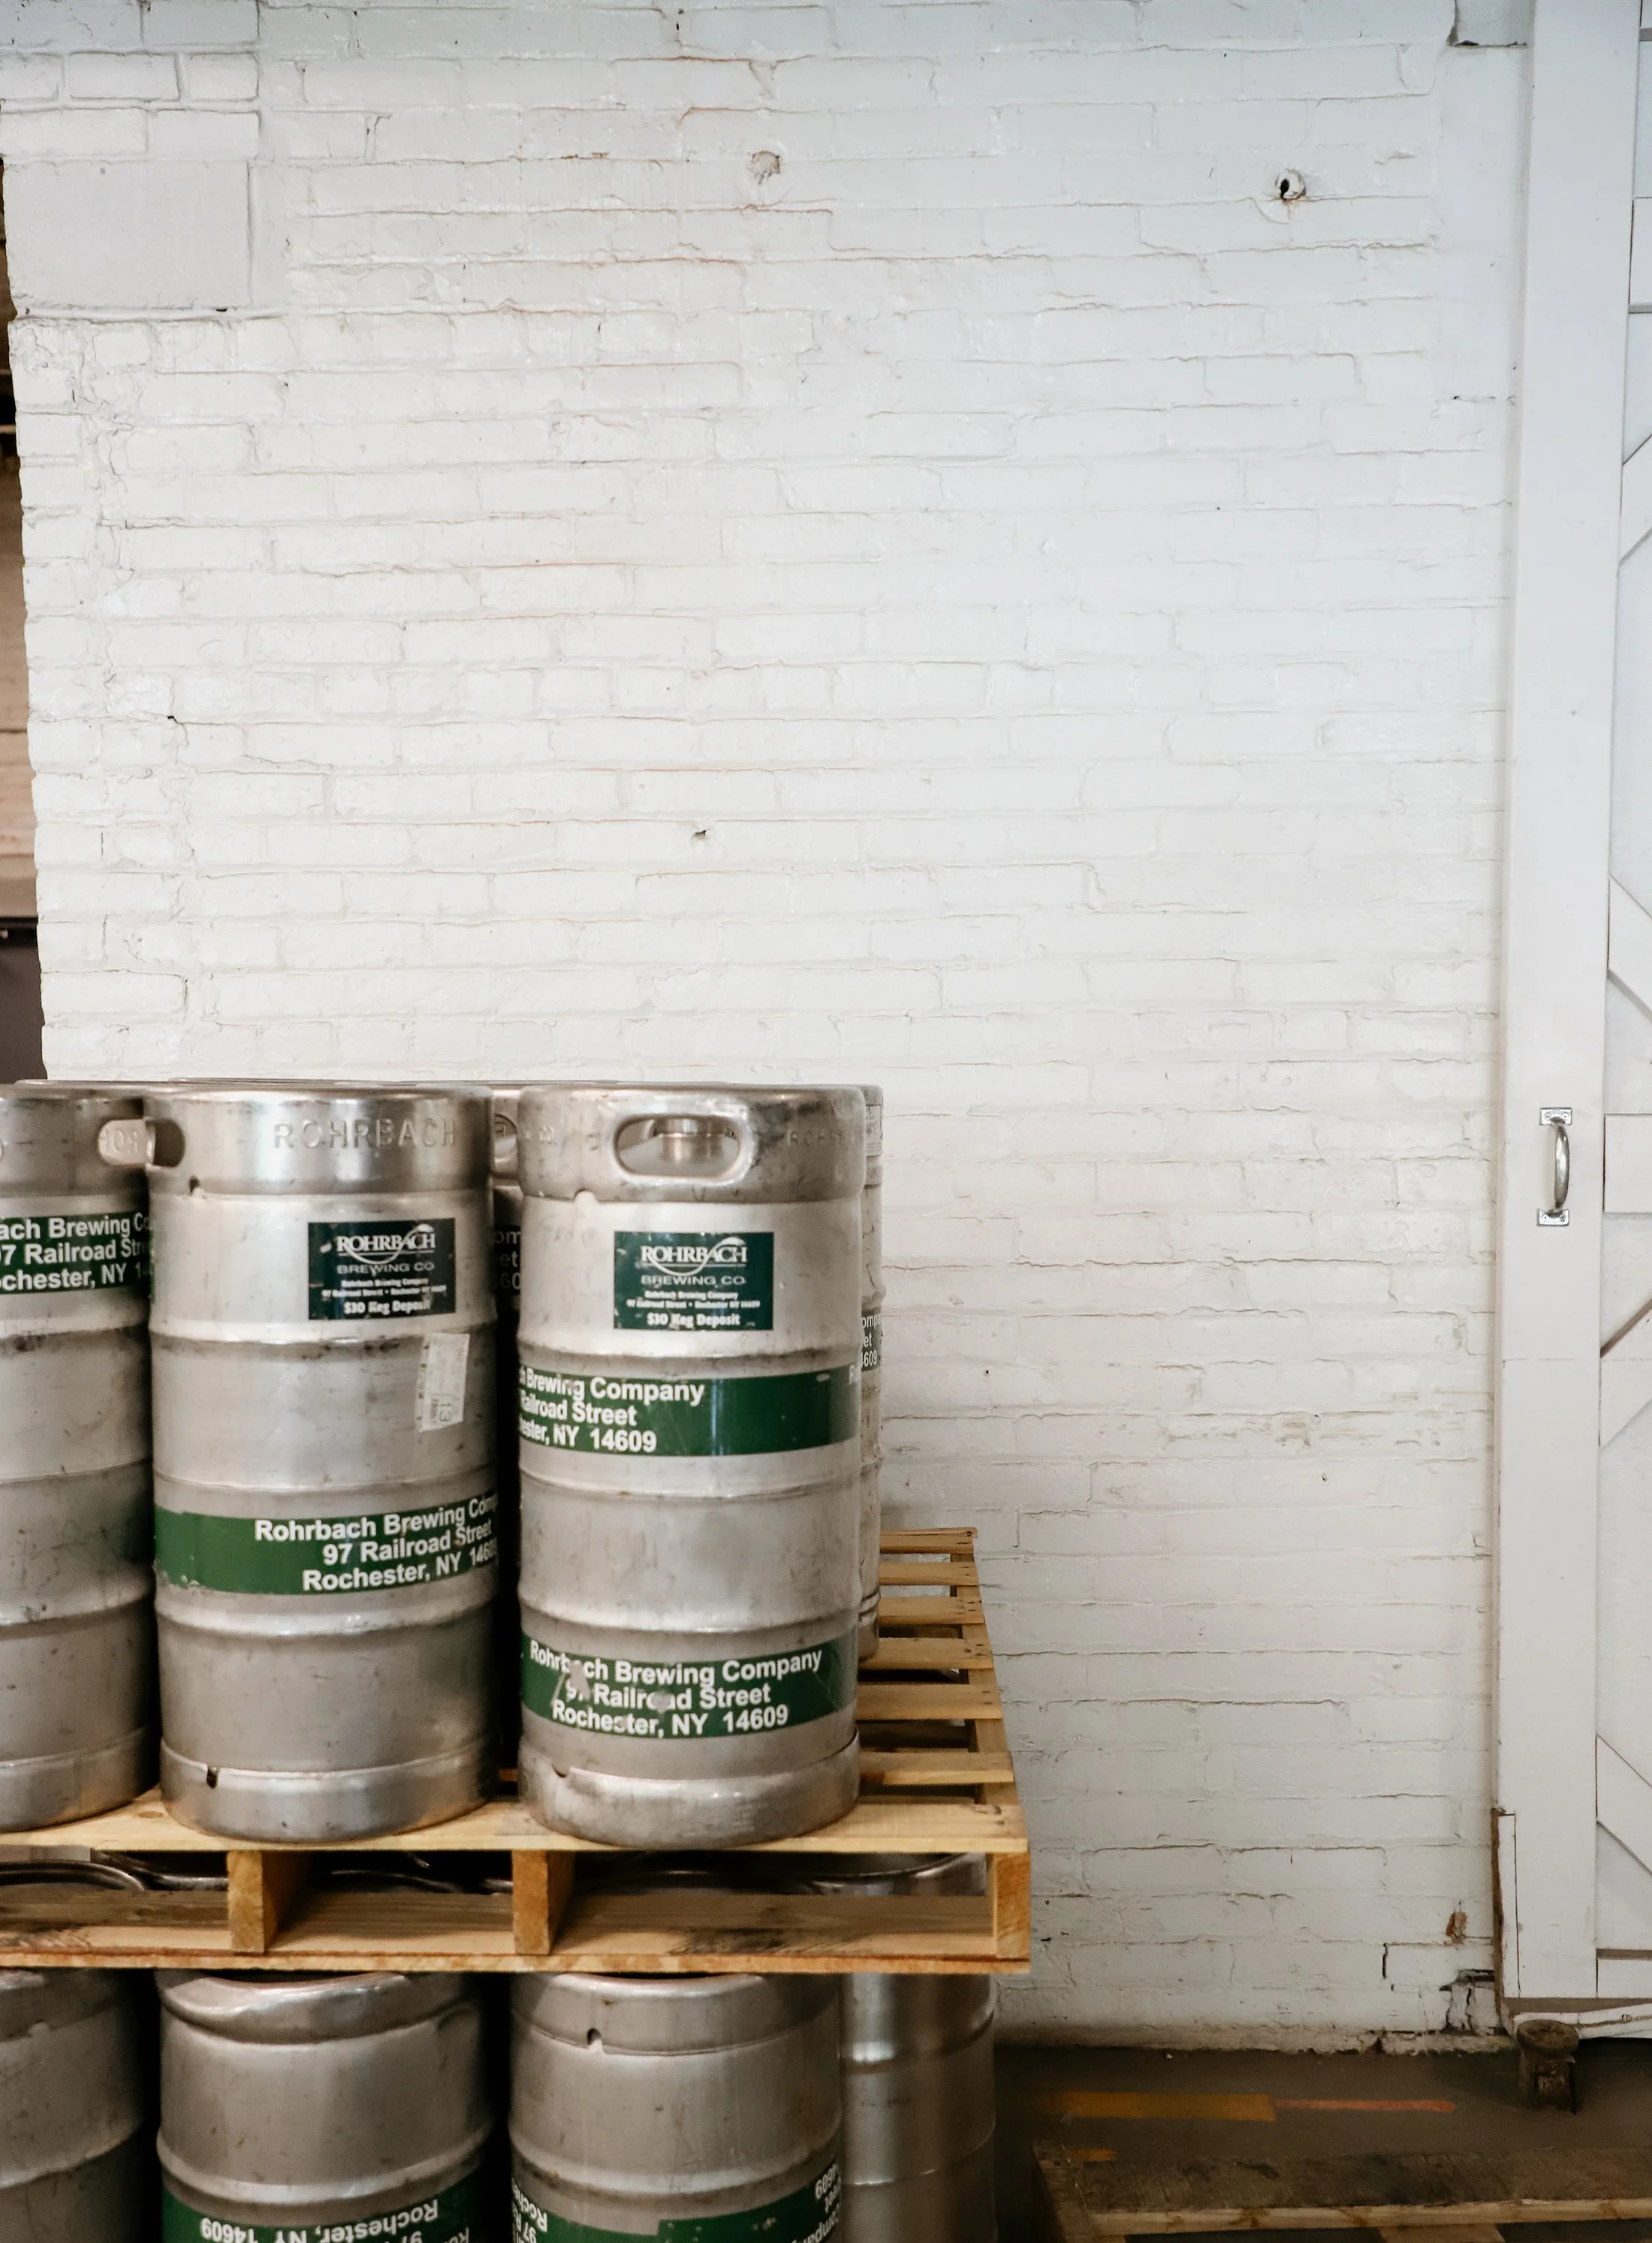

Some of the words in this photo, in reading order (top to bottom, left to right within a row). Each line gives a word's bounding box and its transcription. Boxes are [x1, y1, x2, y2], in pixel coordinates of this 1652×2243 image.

[273, 1118, 455, 1149] ROHRBACH
[48, 1215, 130, 1238] Brewing
[0, 1244, 17, 1266] 7
[24, 1239, 116, 1265] Railroad
[336, 1232, 436, 1252] ROHRBACH
[641, 1245, 747, 1263] ROHRBACH
[0, 1268, 95, 1291] chester,
[101, 1262, 126, 1284] NY
[337, 1262, 410, 1275] BREWING
[641, 1275, 716, 1286] BREWING
[344, 1301, 366, 1314] $30
[368, 1301, 390, 1315] Keg
[647, 1313, 668, 1326] $30
[671, 1313, 694, 1328] Keg
[696, 1313, 740, 1328] Deposit
[861, 1349, 877, 1367] 609
[526, 1367, 585, 1401] Brewing
[590, 1376, 705, 1406] Company
[572, 1401, 638, 1426] Street
[553, 1423, 580, 1447] NY
[589, 1428, 657, 1452] 14609
[255, 1517, 375, 1541] Rohrbach
[384, 1506, 465, 1536] Brewing
[322, 1543, 353, 1566] 97
[360, 1529, 451, 1563] Railroad
[455, 1519, 492, 1547] Street
[303, 1563, 431, 1591] Rochester,
[436, 1551, 463, 1576] NY
[530, 1639, 609, 1681] Rohrbch
[615, 1660, 715, 1689] Brewing
[722, 1651, 823, 1681] Company
[700, 1682, 770, 1710] Street
[552, 1699, 665, 1738] Rochester,
[672, 1713, 710, 1735] NY
[723, 1705, 788, 1732] 14609
[315, 2199, 439, 2243] Rochester,
